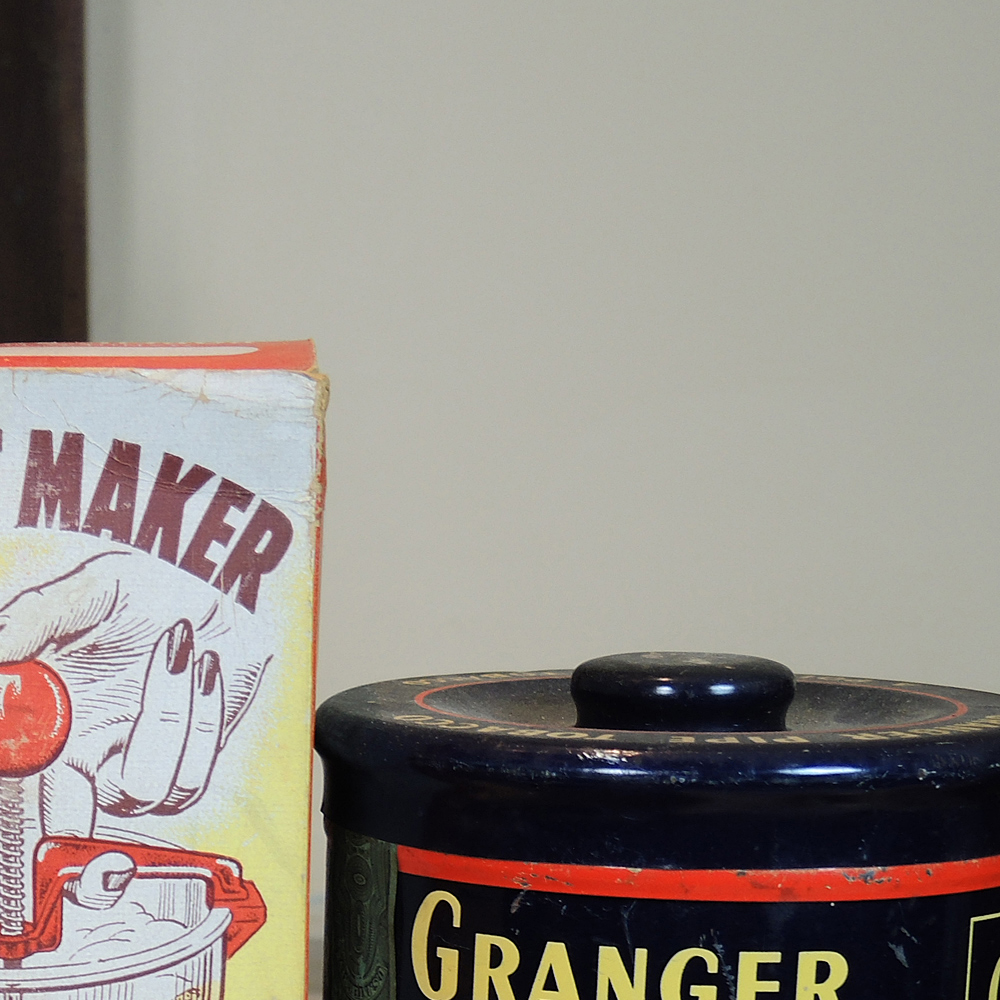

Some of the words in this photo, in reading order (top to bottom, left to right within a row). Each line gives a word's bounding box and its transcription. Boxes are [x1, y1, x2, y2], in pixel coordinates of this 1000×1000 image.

[15, 429, 294, 614] MAKER
[393, 714, 617, 742] TOBACCO
[669, 735, 809, 744] PIPE
